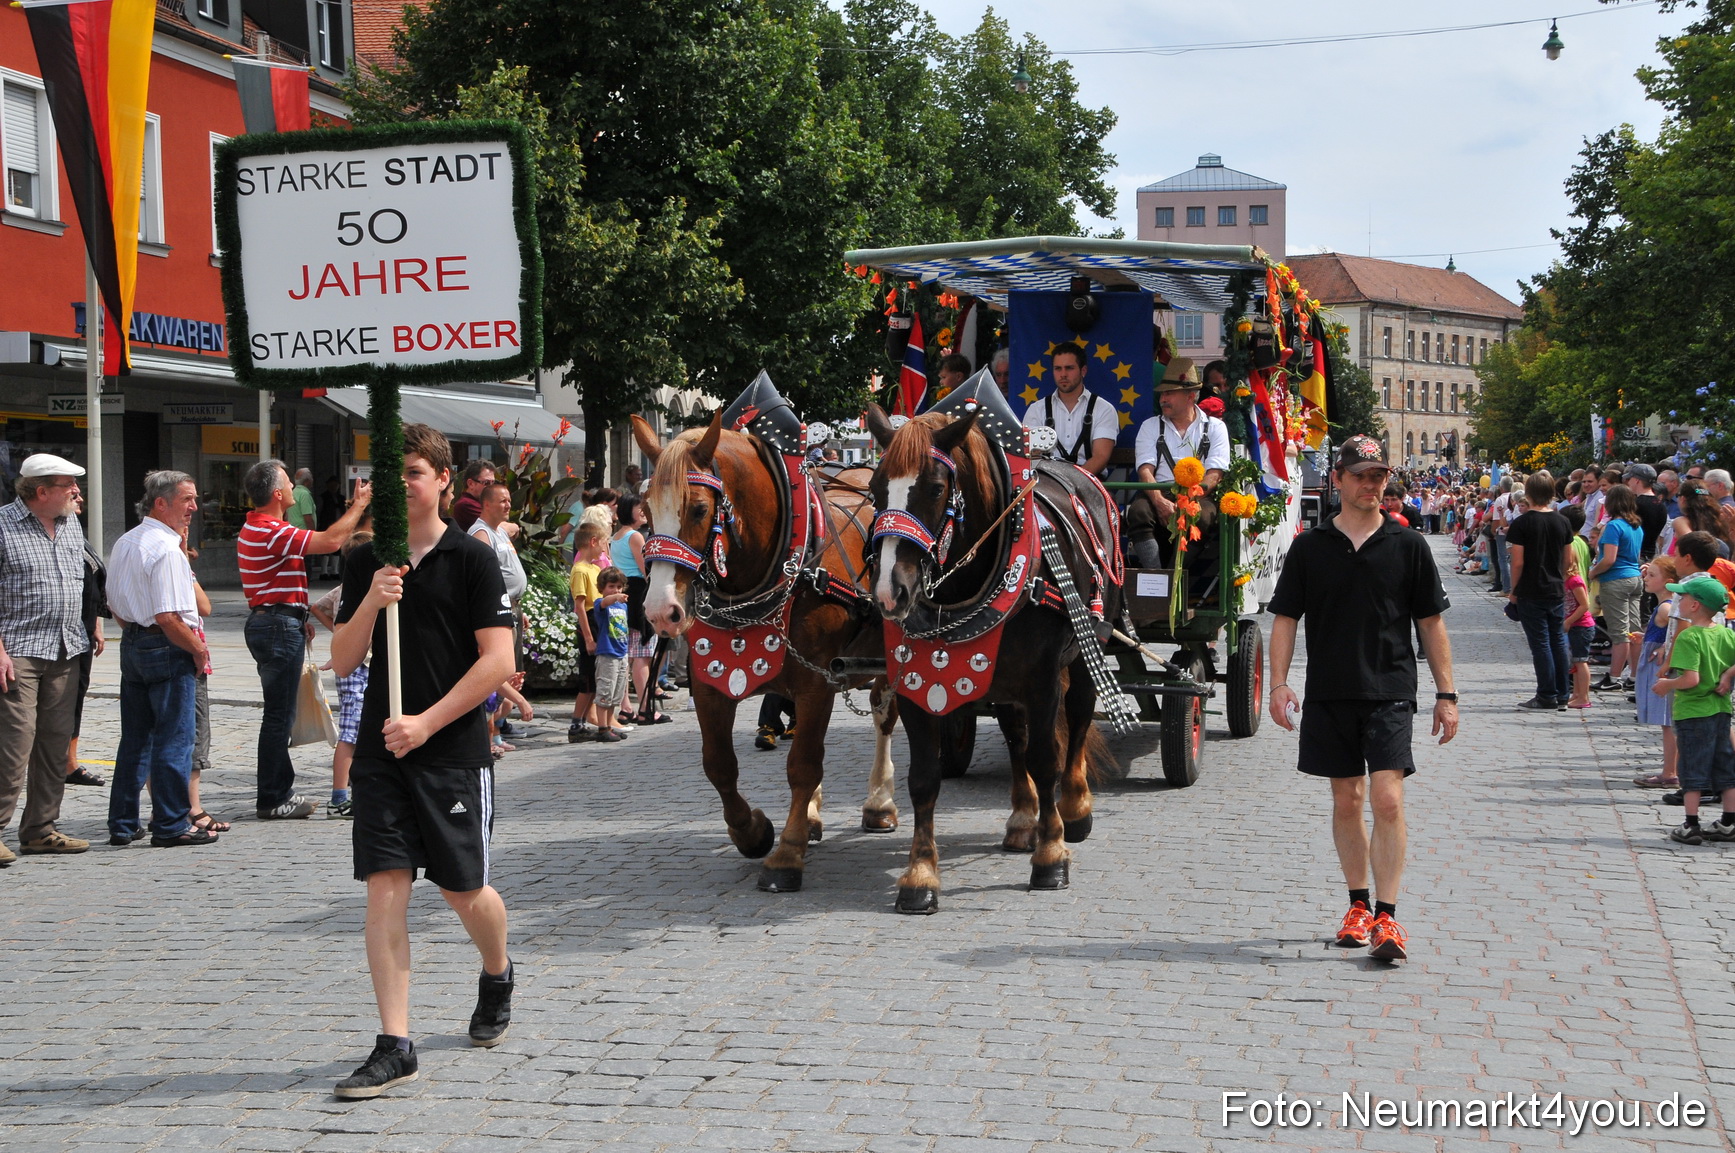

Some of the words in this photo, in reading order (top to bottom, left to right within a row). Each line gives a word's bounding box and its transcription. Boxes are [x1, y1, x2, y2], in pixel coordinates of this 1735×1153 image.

[237, 160, 367, 195] STARKE
[384, 152, 502, 186] STADT
[337, 208, 408, 246] 50
[288, 255, 470, 300] JAHRE
[71, 302, 224, 351] TAKWAREN
[251, 326, 379, 360] STARKE
[393, 320, 520, 352] BOXER
[52, 399, 76, 410] NZ
[170, 406, 226, 415] NEUMARKTER
